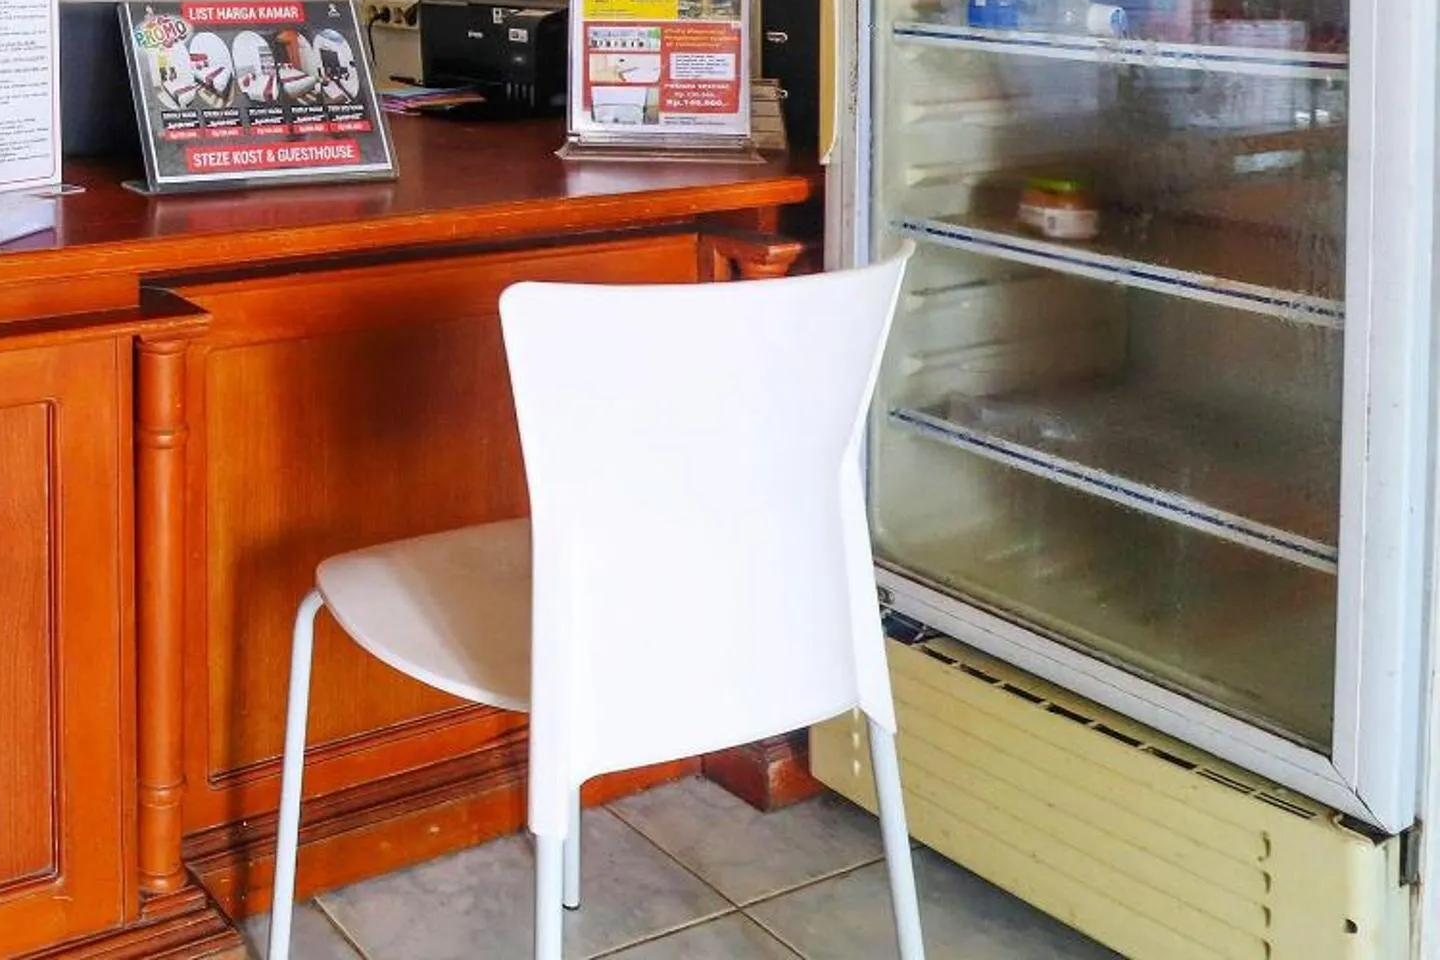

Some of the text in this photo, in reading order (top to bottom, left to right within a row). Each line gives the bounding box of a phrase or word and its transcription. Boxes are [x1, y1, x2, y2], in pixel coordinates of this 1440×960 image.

[189, 5, 299, 20] LIST HARGA KAMAR
[134, 20, 188, 49] PROMO
[192, 144, 355, 168] STEZE KOST & GUESTHOUSE
